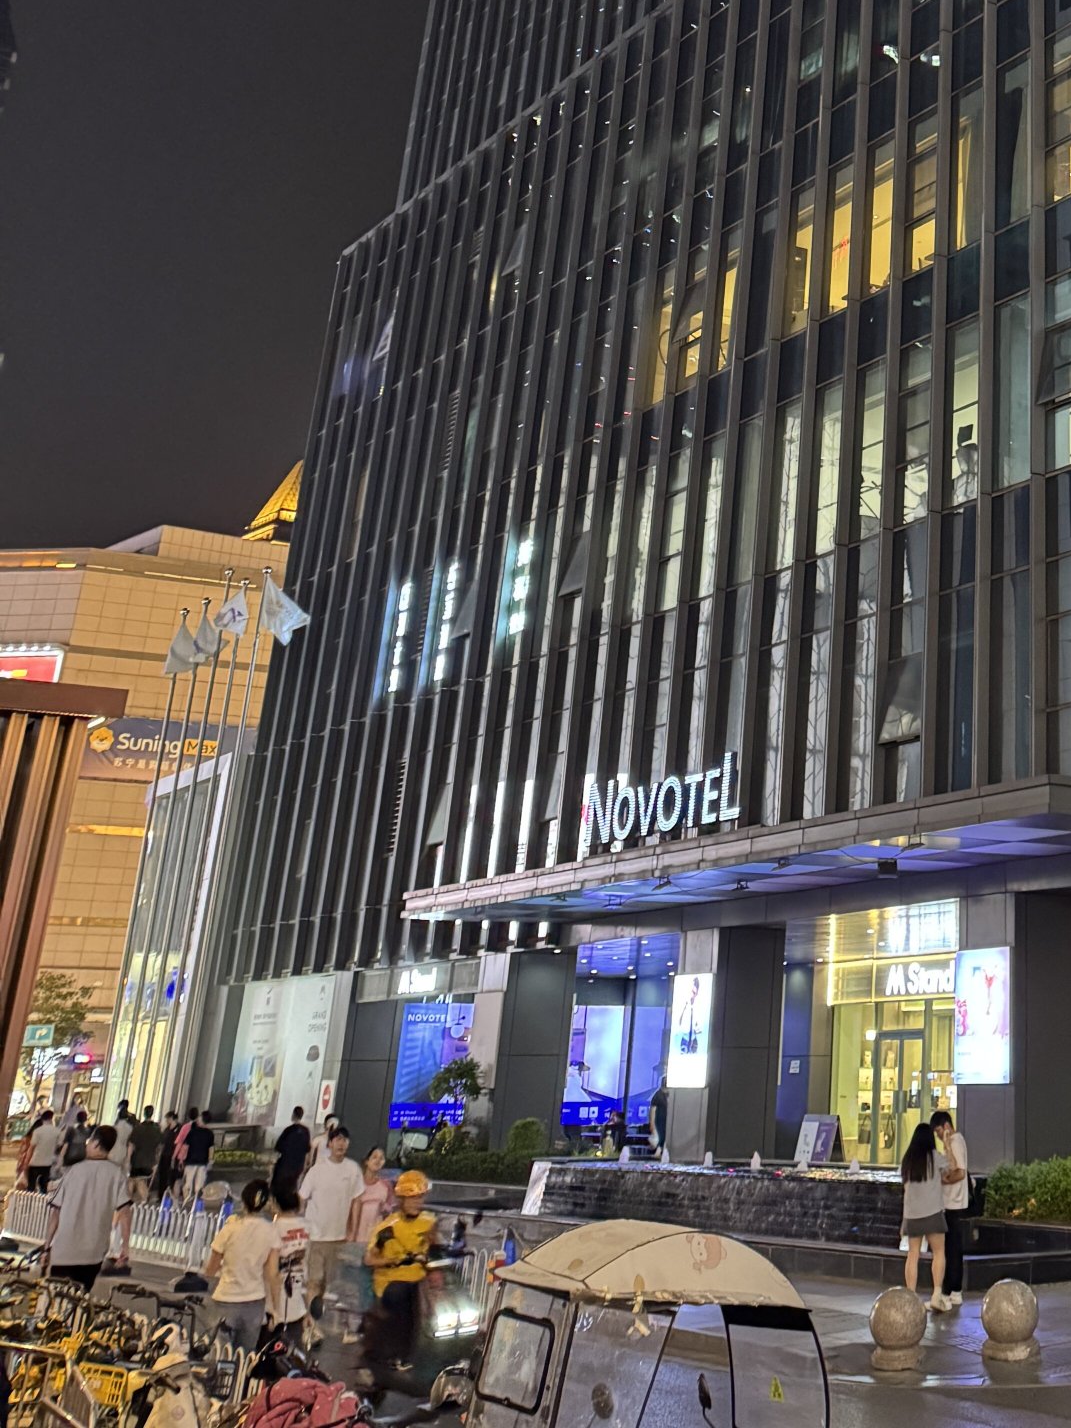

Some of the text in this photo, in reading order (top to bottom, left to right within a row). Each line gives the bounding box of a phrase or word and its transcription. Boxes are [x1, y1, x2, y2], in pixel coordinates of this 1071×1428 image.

[117, 733, 181, 759] Suning
[584, 751, 741, 847] NOVOTEL
[907, 961, 955, 995] Stand
[407, 1013, 448, 1023] NOVOTE
